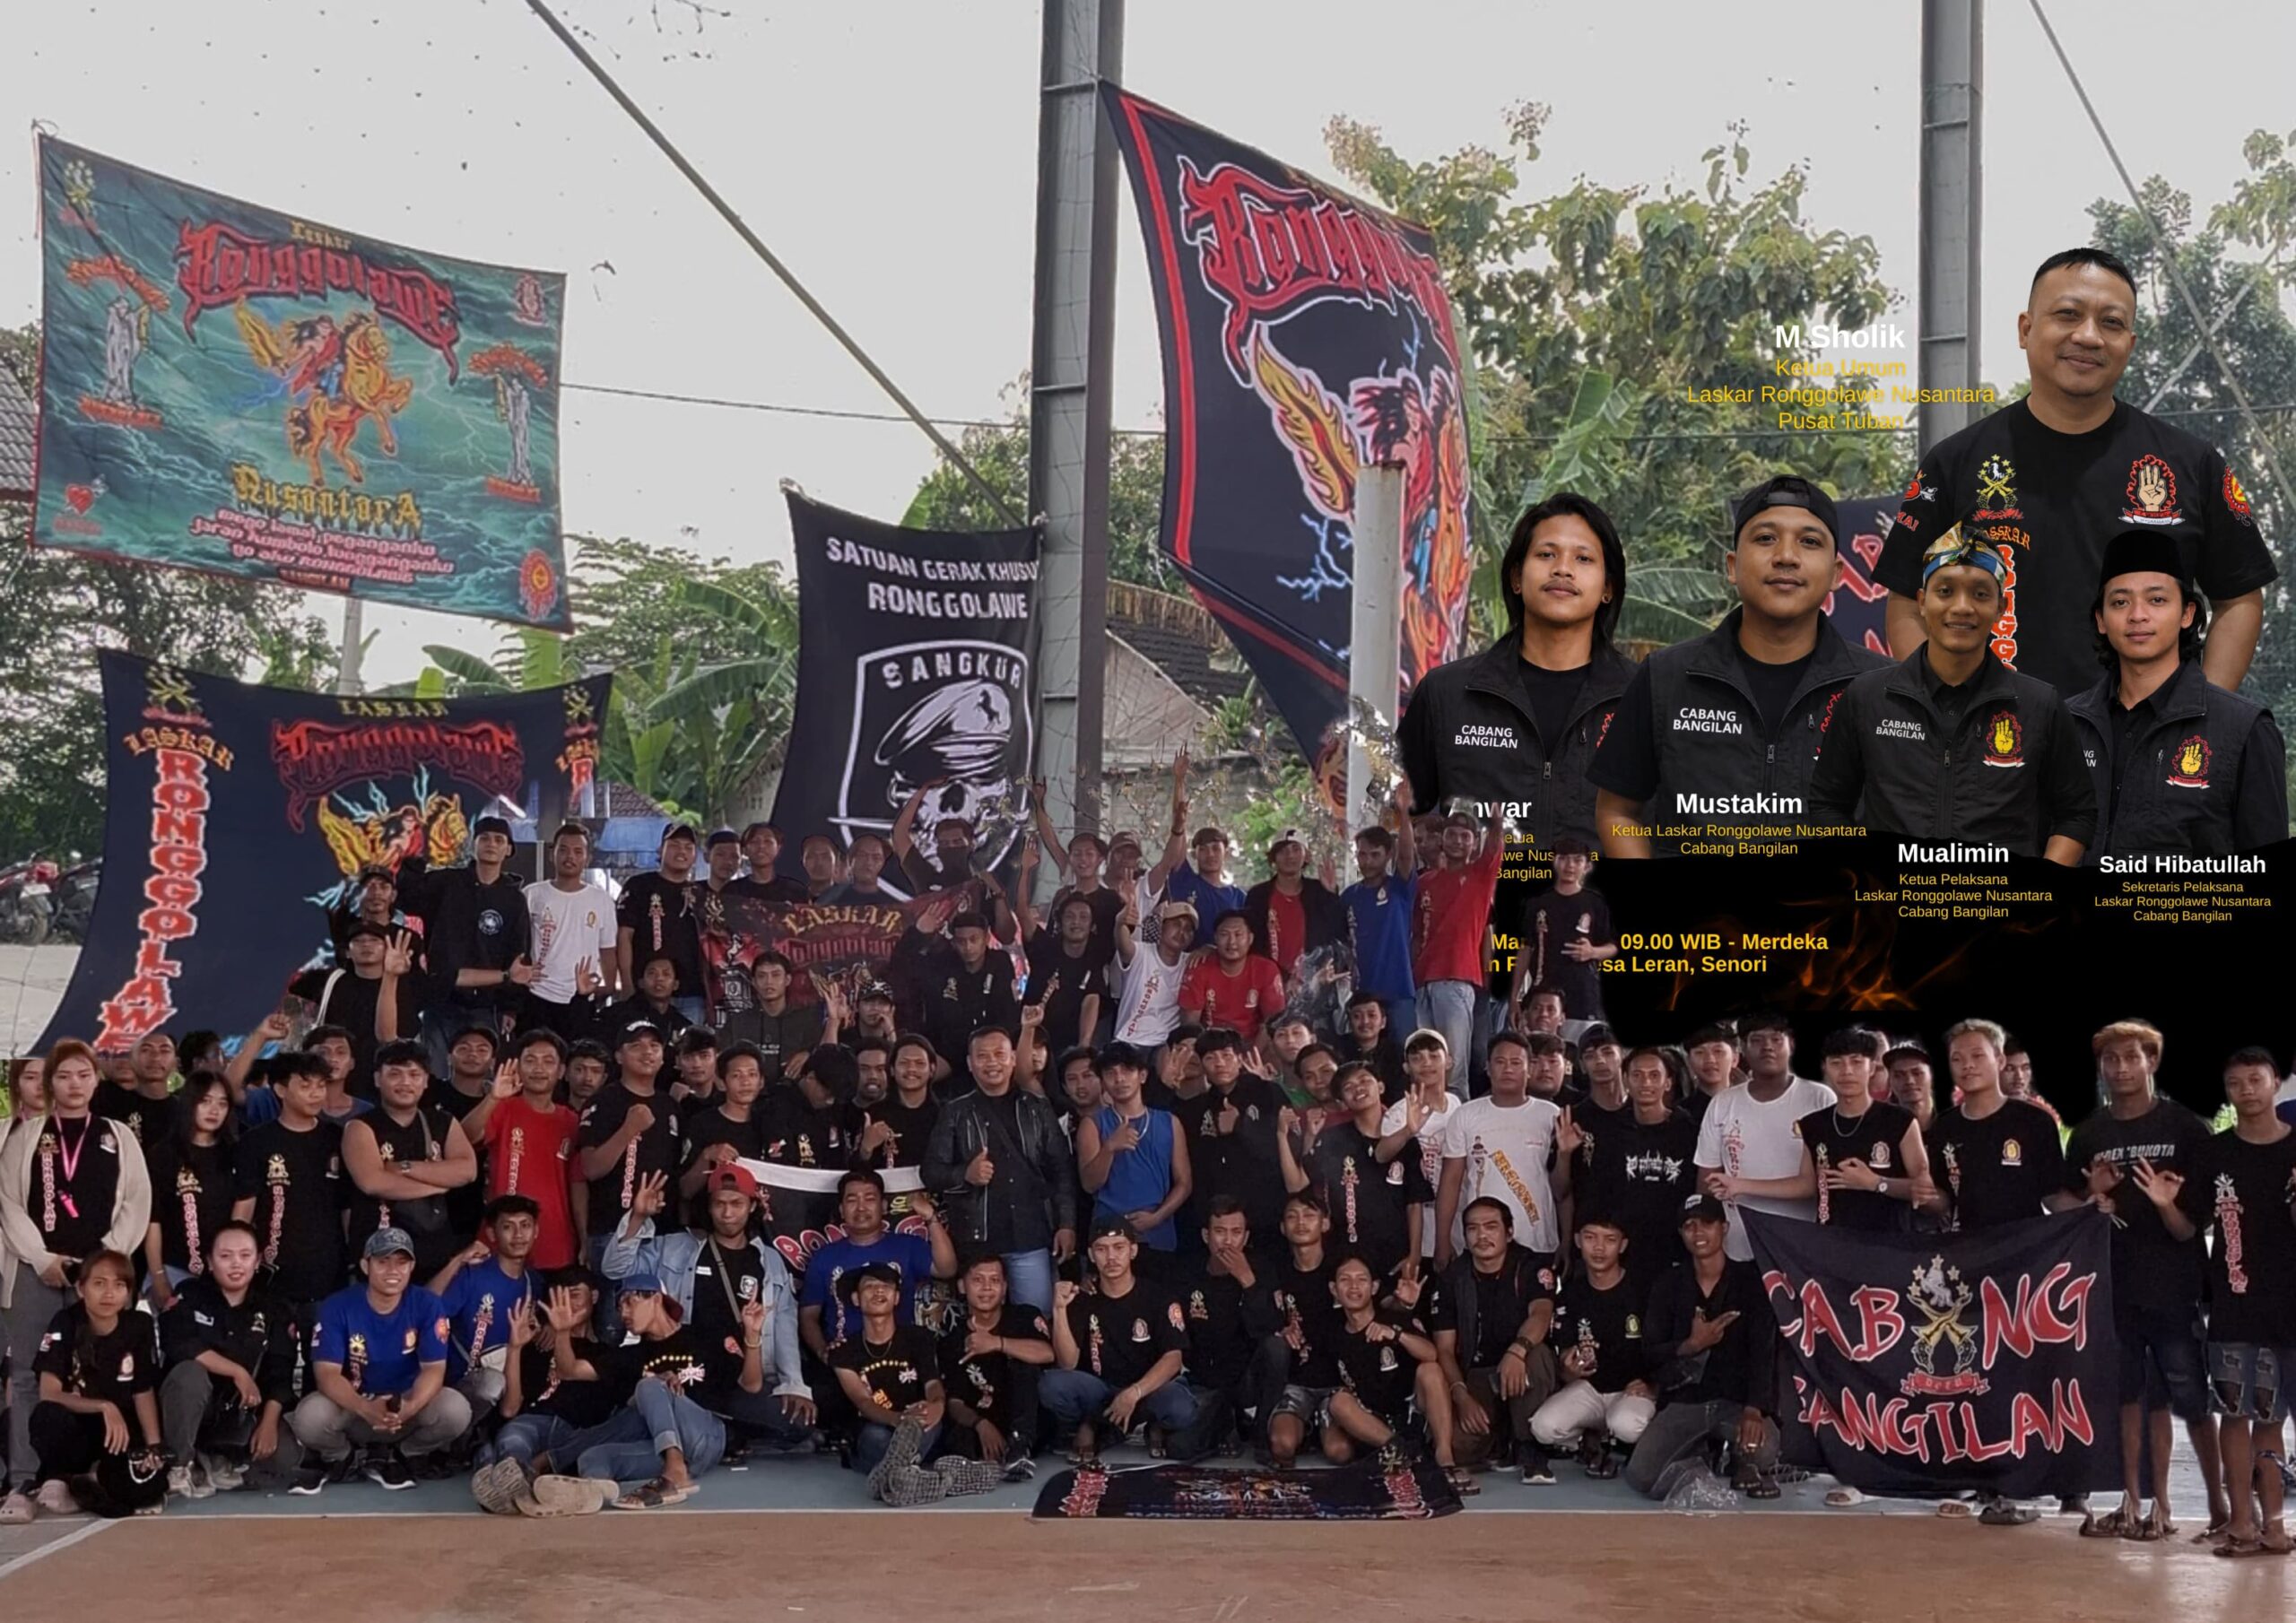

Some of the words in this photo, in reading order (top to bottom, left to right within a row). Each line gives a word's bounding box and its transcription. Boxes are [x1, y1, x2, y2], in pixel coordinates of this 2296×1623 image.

[826, 537, 918, 579] SATUAN
[923, 559, 986, 582] GERAK
[867, 583, 1029, 620] RONGGOLAWE
[883, 651, 1022, 690] SANGKUR
[1679, 707, 1736, 722] CABANG
[1461, 725, 1513, 738] CABANG
[1673, 719, 1743, 734] BANGILAN
[1882, 718, 1921, 732] CABANG
[1876, 726, 1926, 741] BANGILAN
[1455, 734, 1518, 749] BANGILAN
[783, 903, 902, 935] LASKAR
